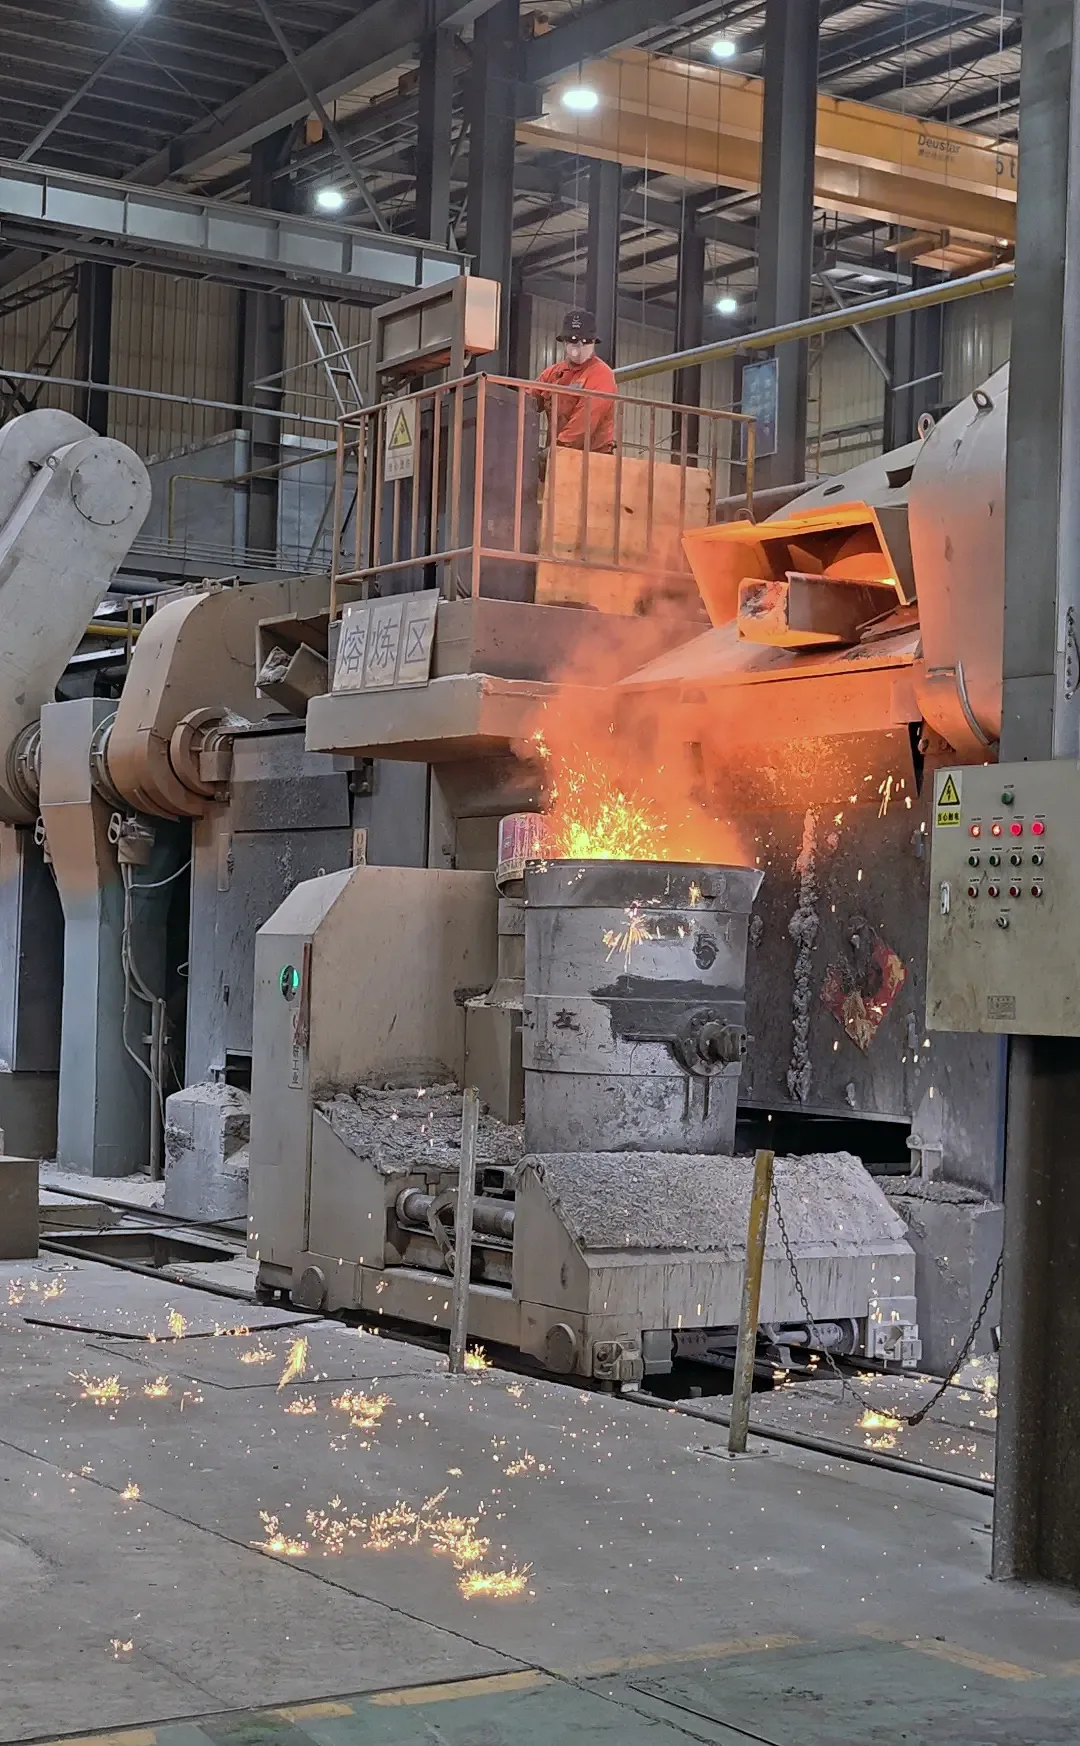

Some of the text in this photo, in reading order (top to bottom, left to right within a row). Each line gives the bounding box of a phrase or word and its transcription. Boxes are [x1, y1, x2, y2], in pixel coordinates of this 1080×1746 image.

[917, 134, 961, 153] Deustar
[337, 616, 430, 675] 熔炼区
[693, 932, 719, 970] 5
